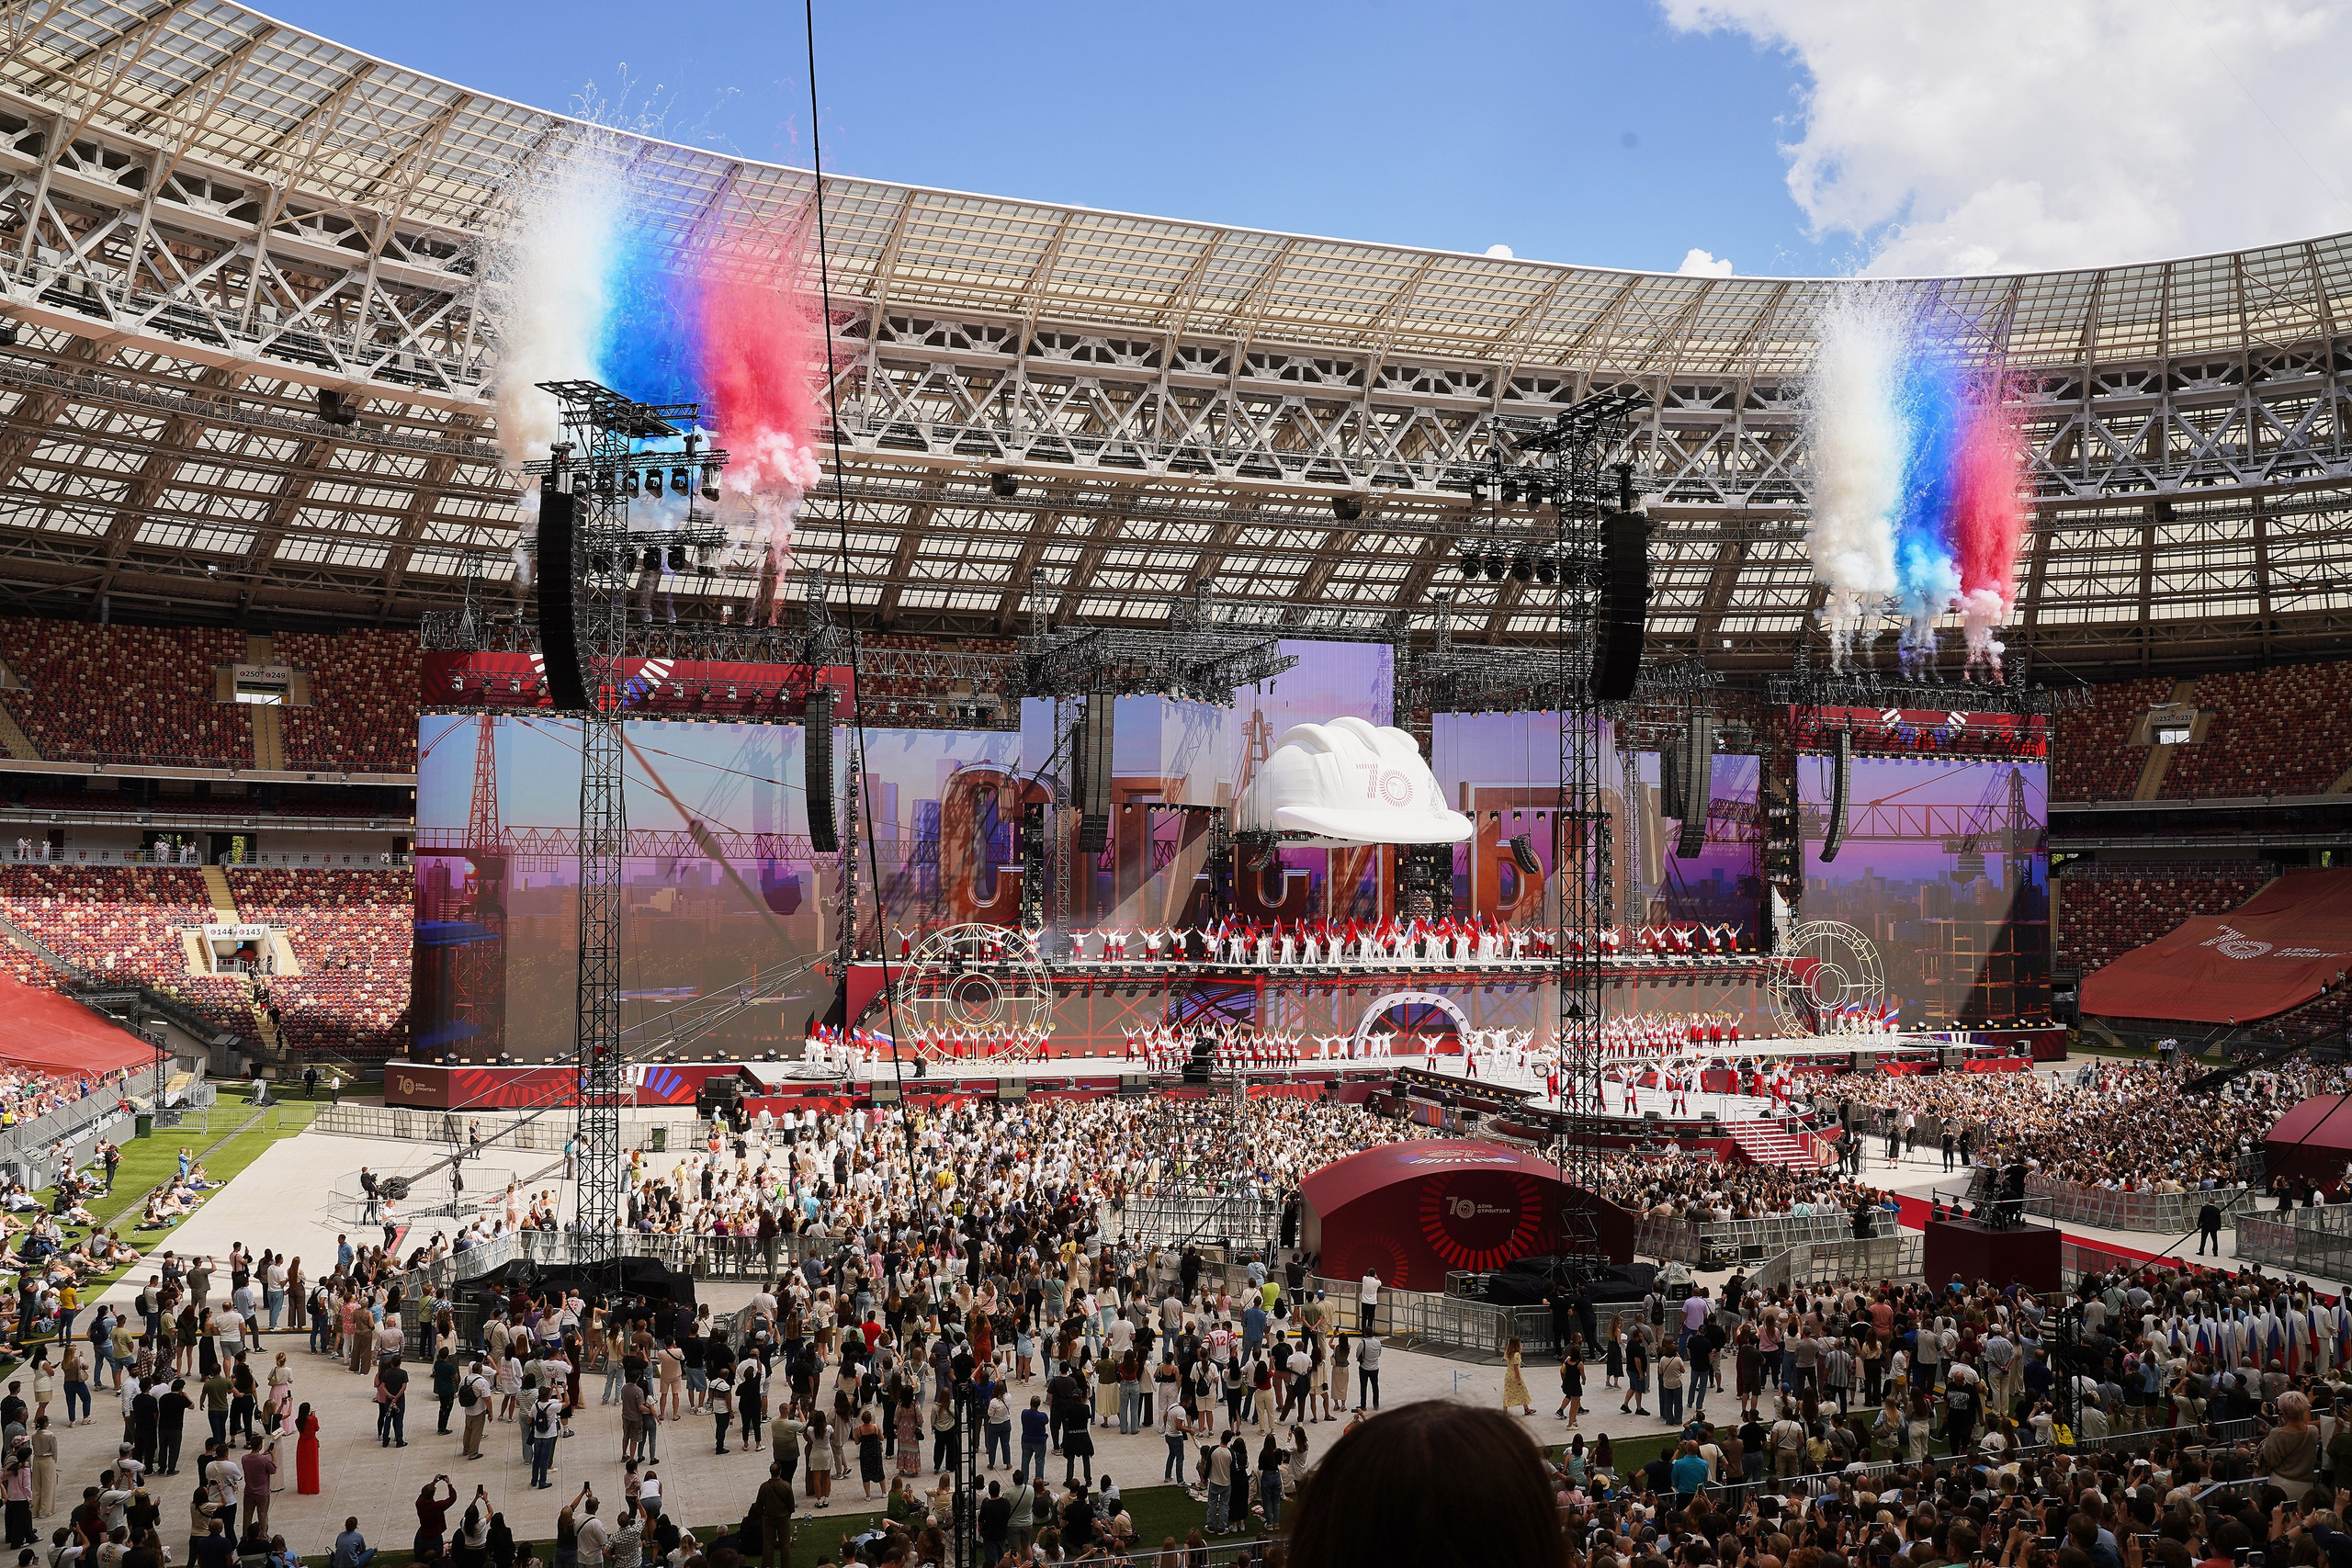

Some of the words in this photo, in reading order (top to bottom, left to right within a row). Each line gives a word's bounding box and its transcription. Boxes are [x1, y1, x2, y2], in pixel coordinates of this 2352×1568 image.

[396, 1075, 414, 1095] 70
[1445, 1196, 1476, 1219] 70
[1216, 1336, 1227, 1347] 12
